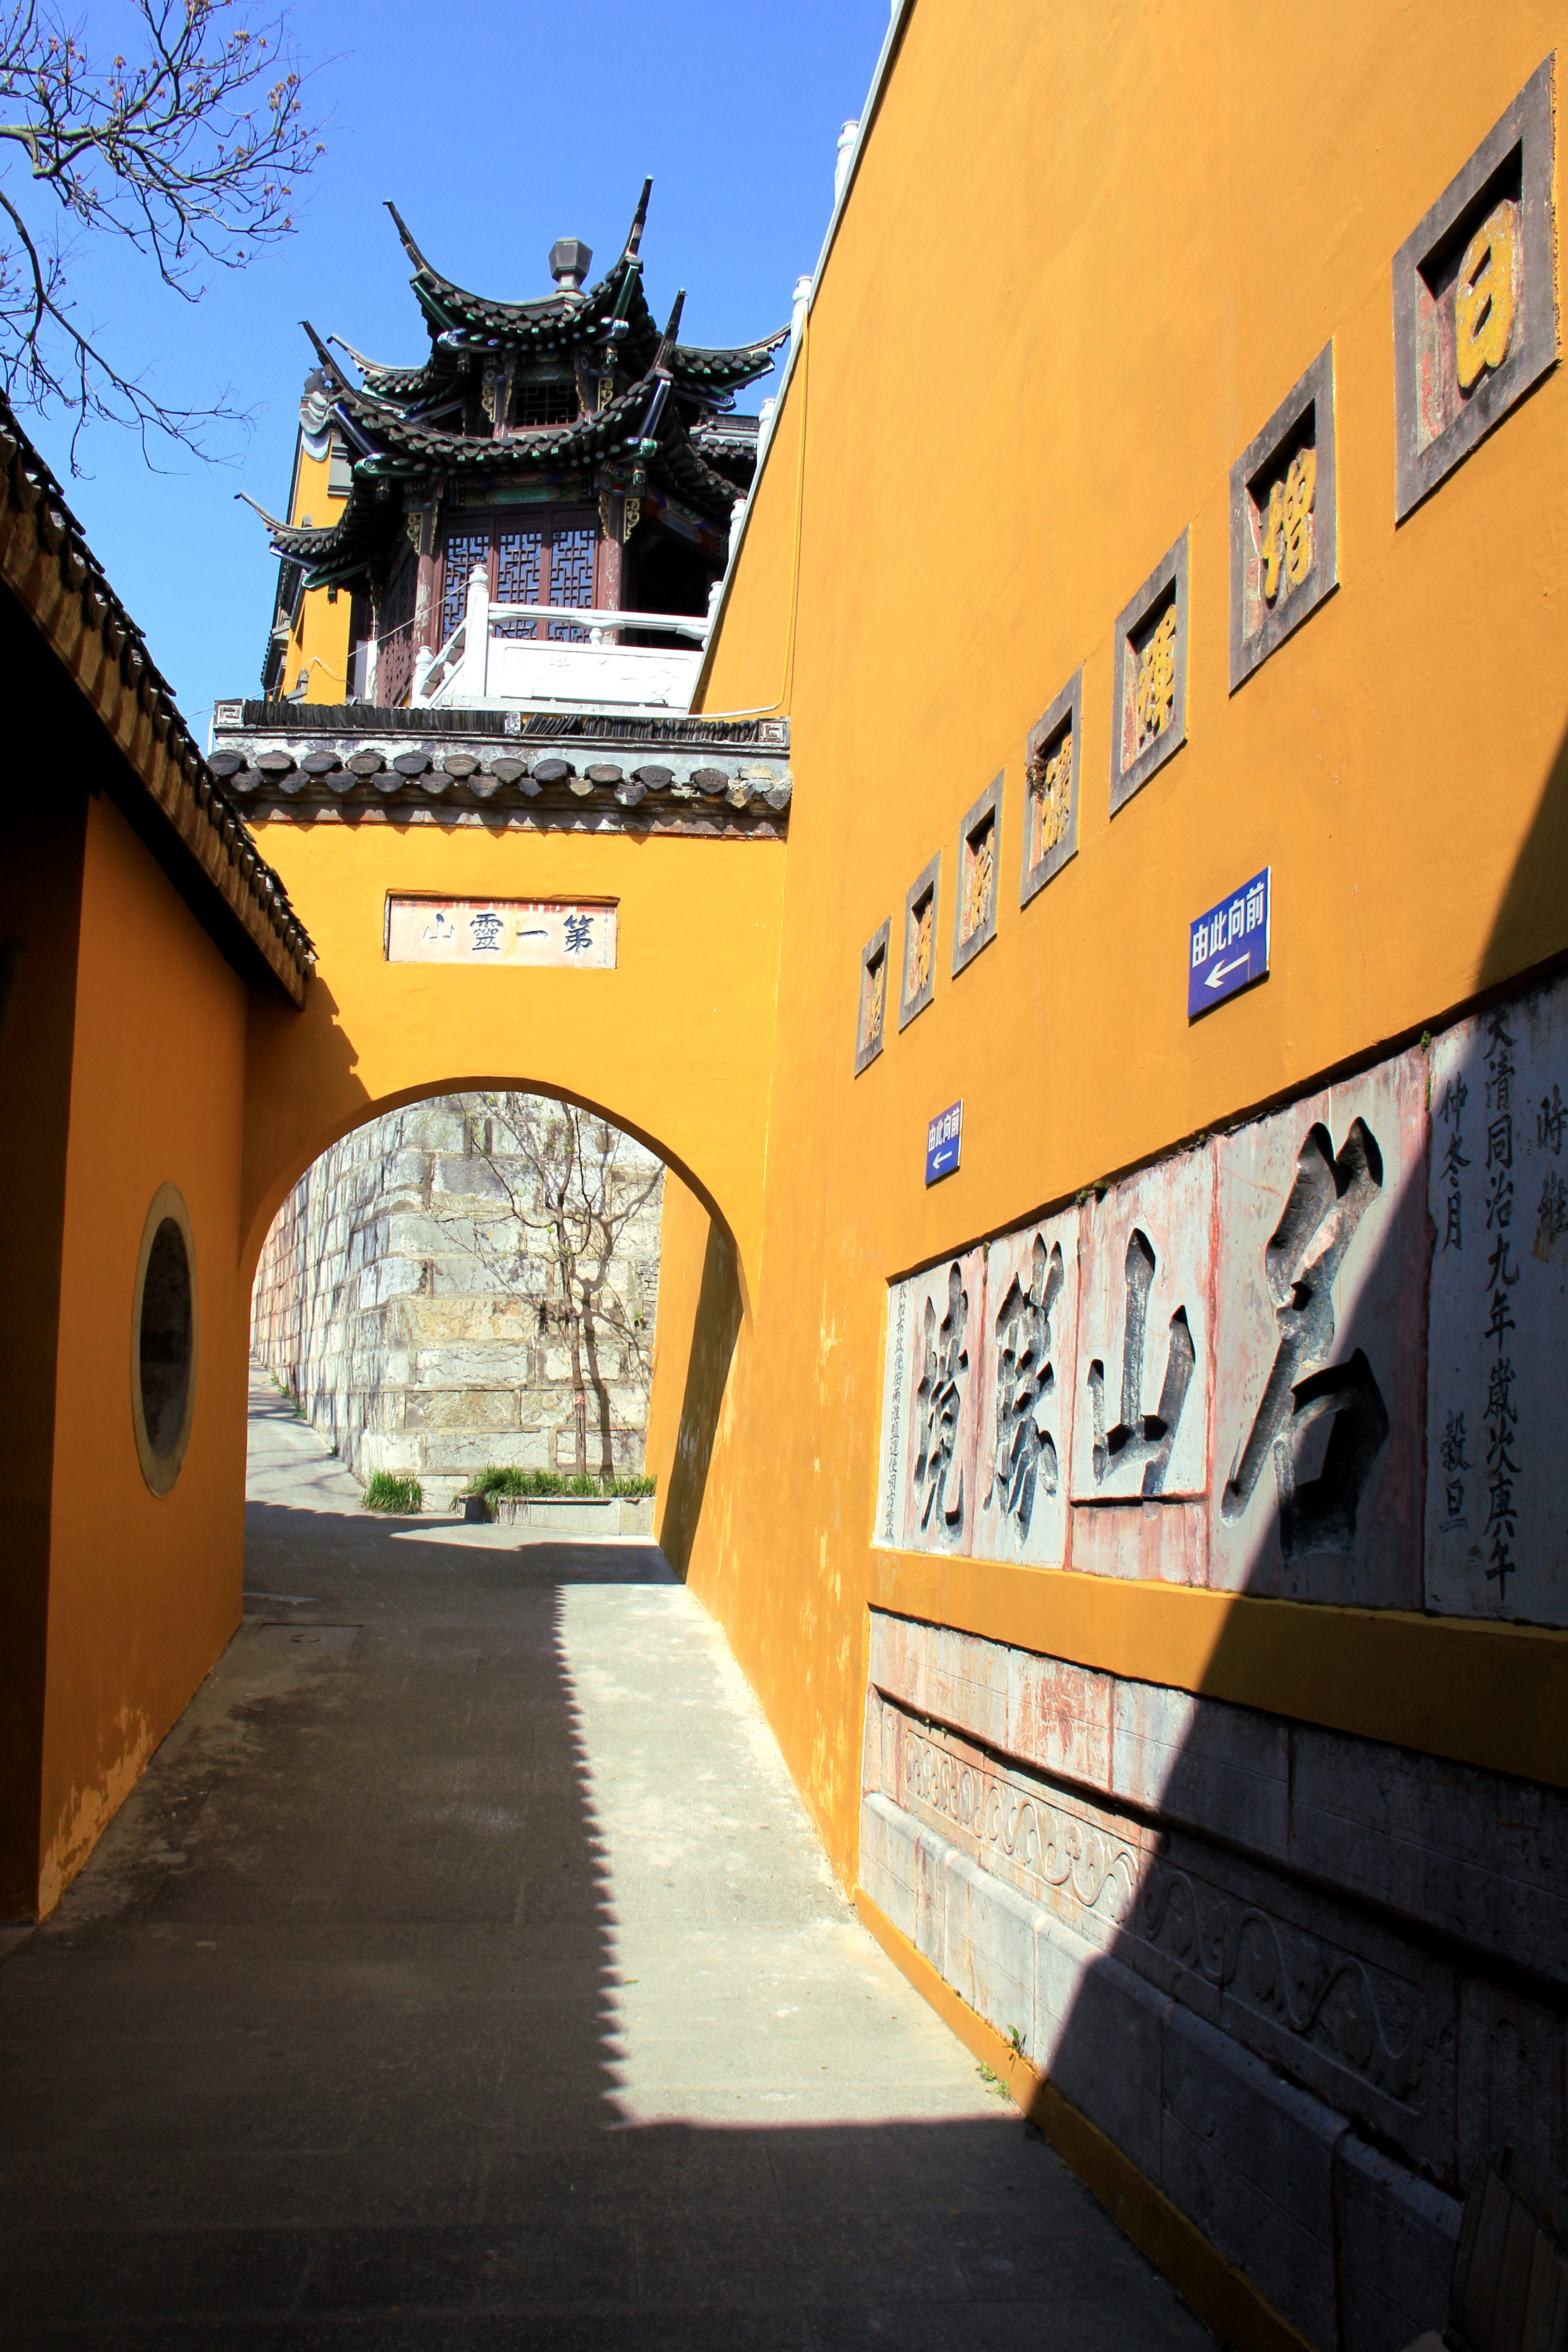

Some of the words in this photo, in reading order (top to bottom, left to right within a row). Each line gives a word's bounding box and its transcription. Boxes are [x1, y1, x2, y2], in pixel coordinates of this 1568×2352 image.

[423, 913, 594, 957] 第一靈山
[1191, 881, 1265, 968] 由此向前
[928, 1107, 960, 1152] 由此向前
